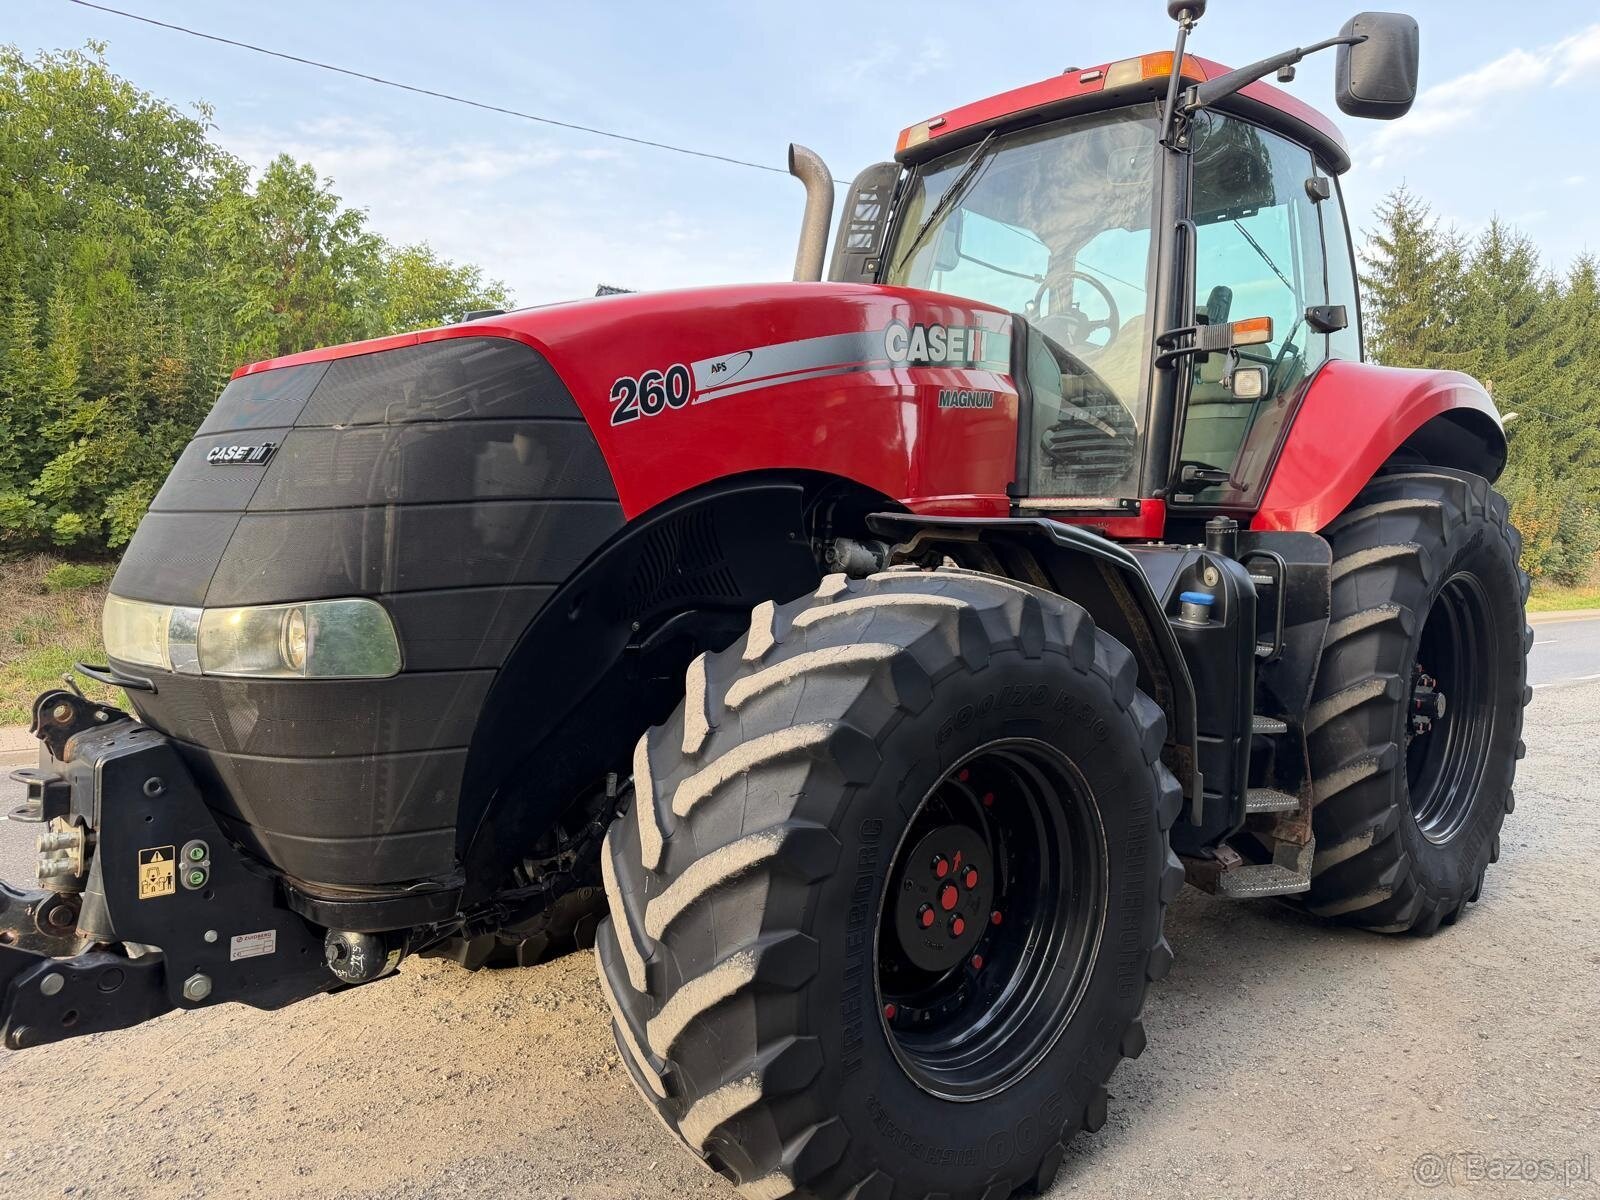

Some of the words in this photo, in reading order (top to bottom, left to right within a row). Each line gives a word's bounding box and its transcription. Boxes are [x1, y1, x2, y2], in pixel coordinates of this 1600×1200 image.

[885, 323, 965, 362] CASE
[711, 362, 728, 374] AFS
[609, 363, 691, 427] 260
[938, 390, 995, 409] MAGNUM
[207, 446, 249, 461] CASE
[839, 816, 884, 1080] TRELLEBORG
